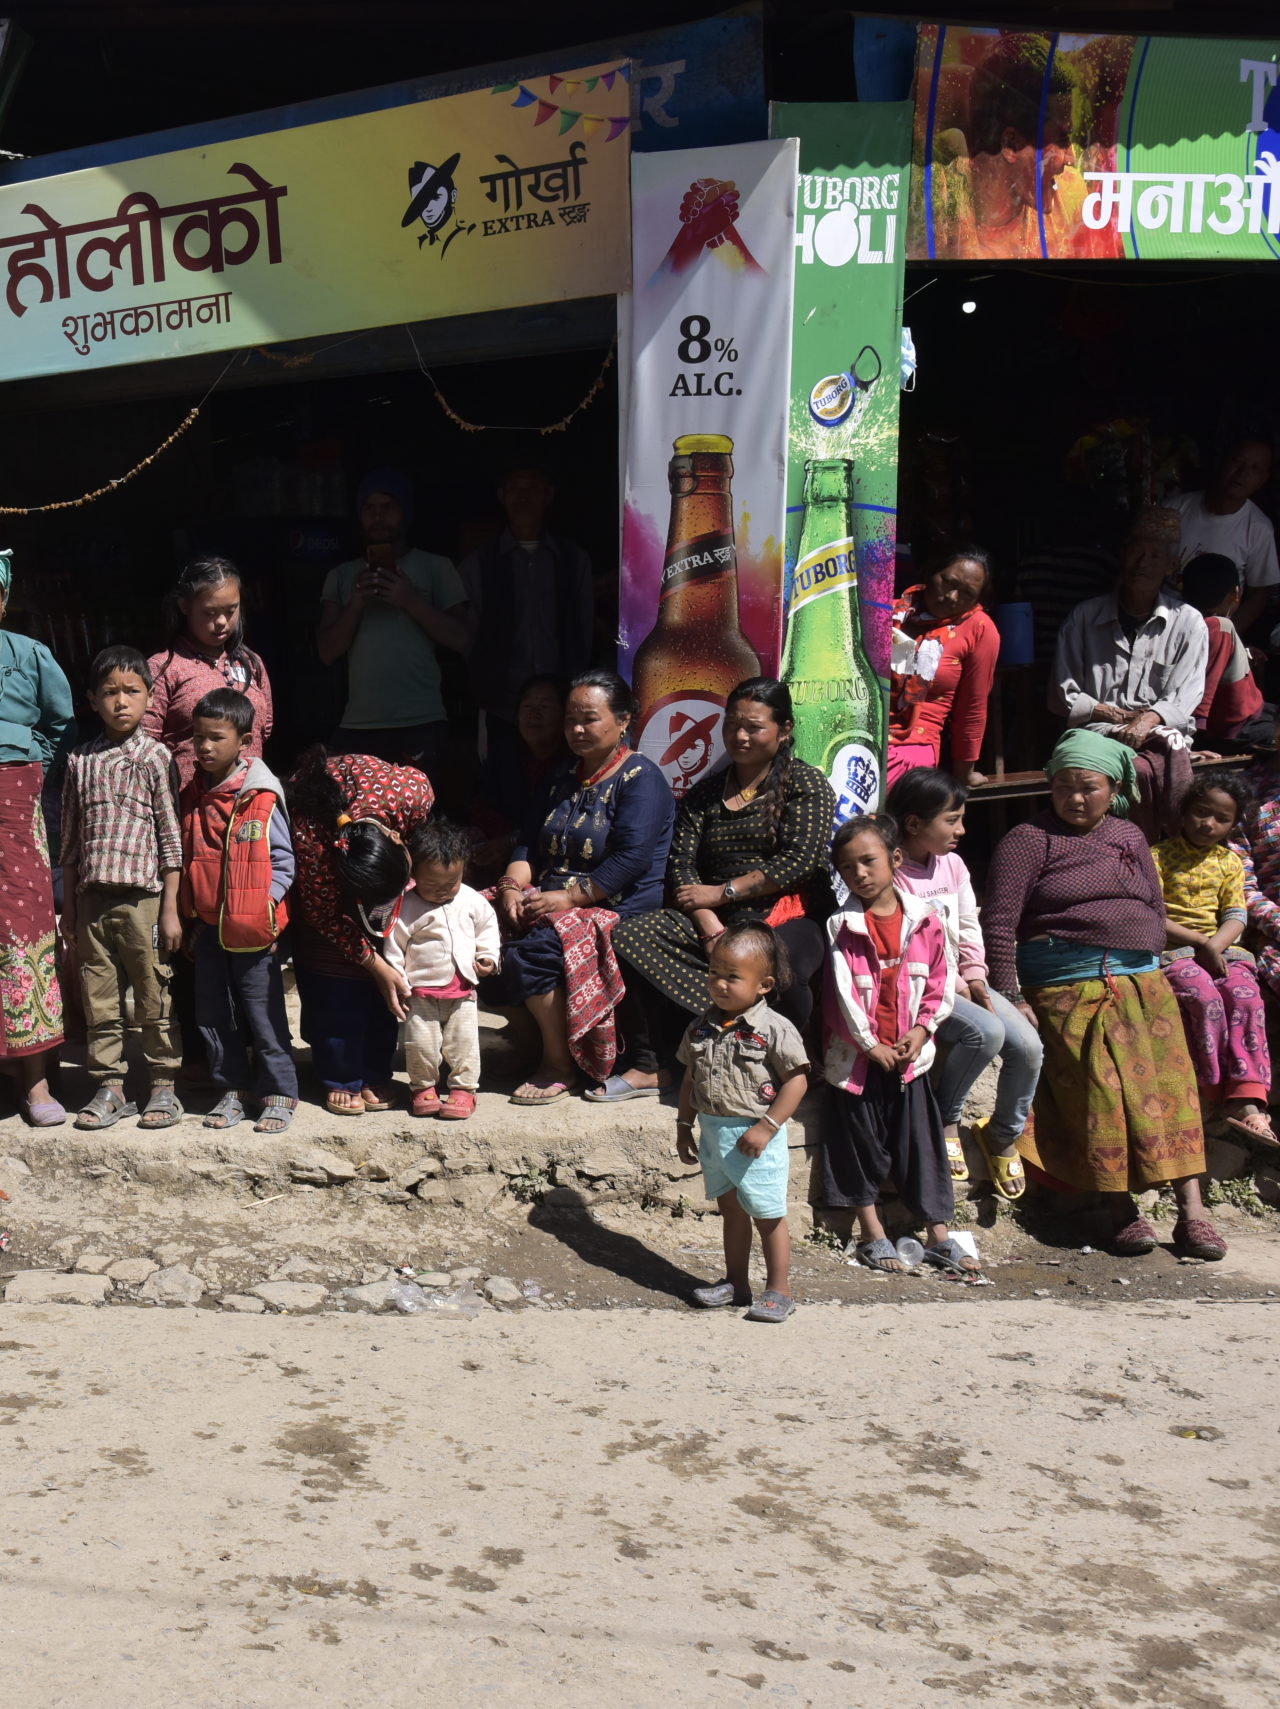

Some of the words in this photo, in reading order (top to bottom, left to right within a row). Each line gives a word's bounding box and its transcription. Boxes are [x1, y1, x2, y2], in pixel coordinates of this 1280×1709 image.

[479, 140, 588, 214] गोर्खा
[0, 162, 288, 318] होलीको
[482, 210, 556, 237] EXTRA
[61, 292, 233, 356] शुभकामना
[677, 314, 739, 364] 8%
[669, 371, 743, 397] ALC.
[812, 378, 848, 411] TUBORG
[666, 551, 715, 580] EXTRA
[792, 549, 856, 600] TUBORG
